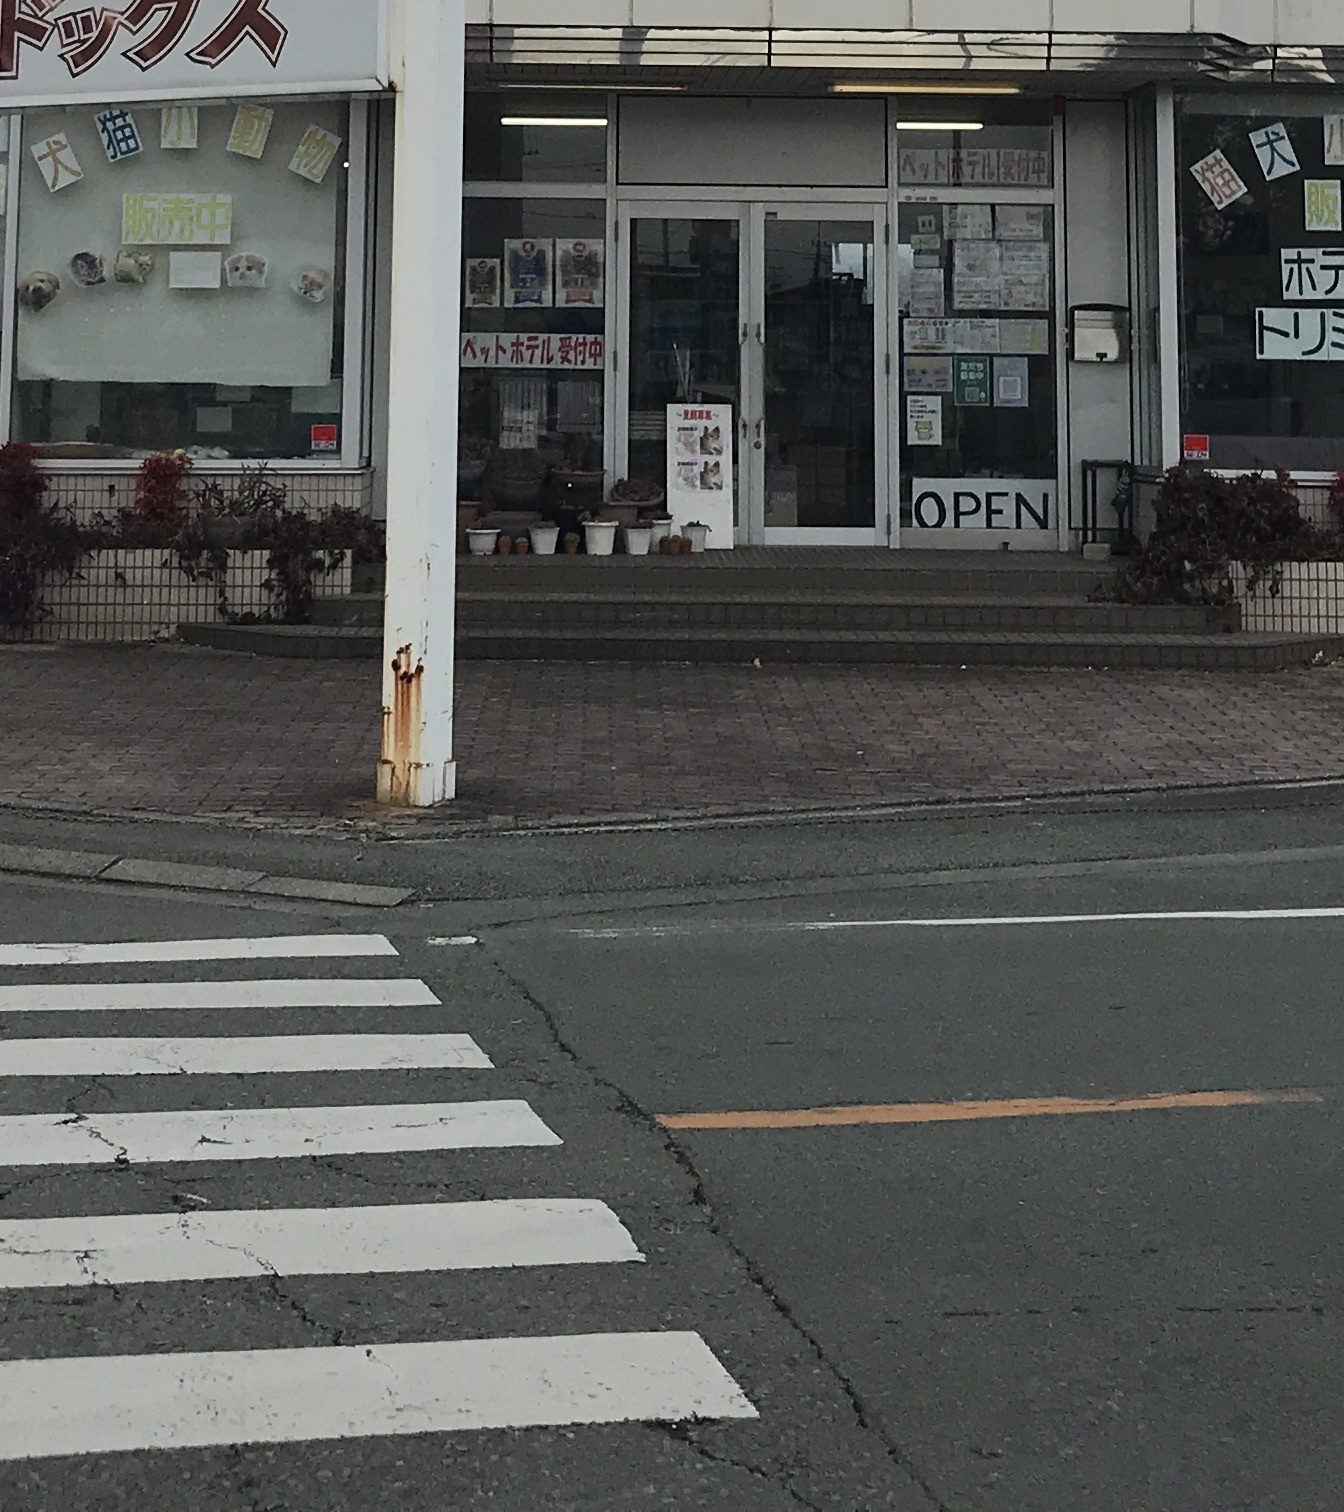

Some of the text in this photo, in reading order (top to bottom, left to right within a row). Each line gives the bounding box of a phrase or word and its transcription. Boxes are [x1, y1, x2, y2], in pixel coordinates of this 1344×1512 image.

[124, 194, 231, 243] 販売中
[914, 491, 1049, 529] OPEN
